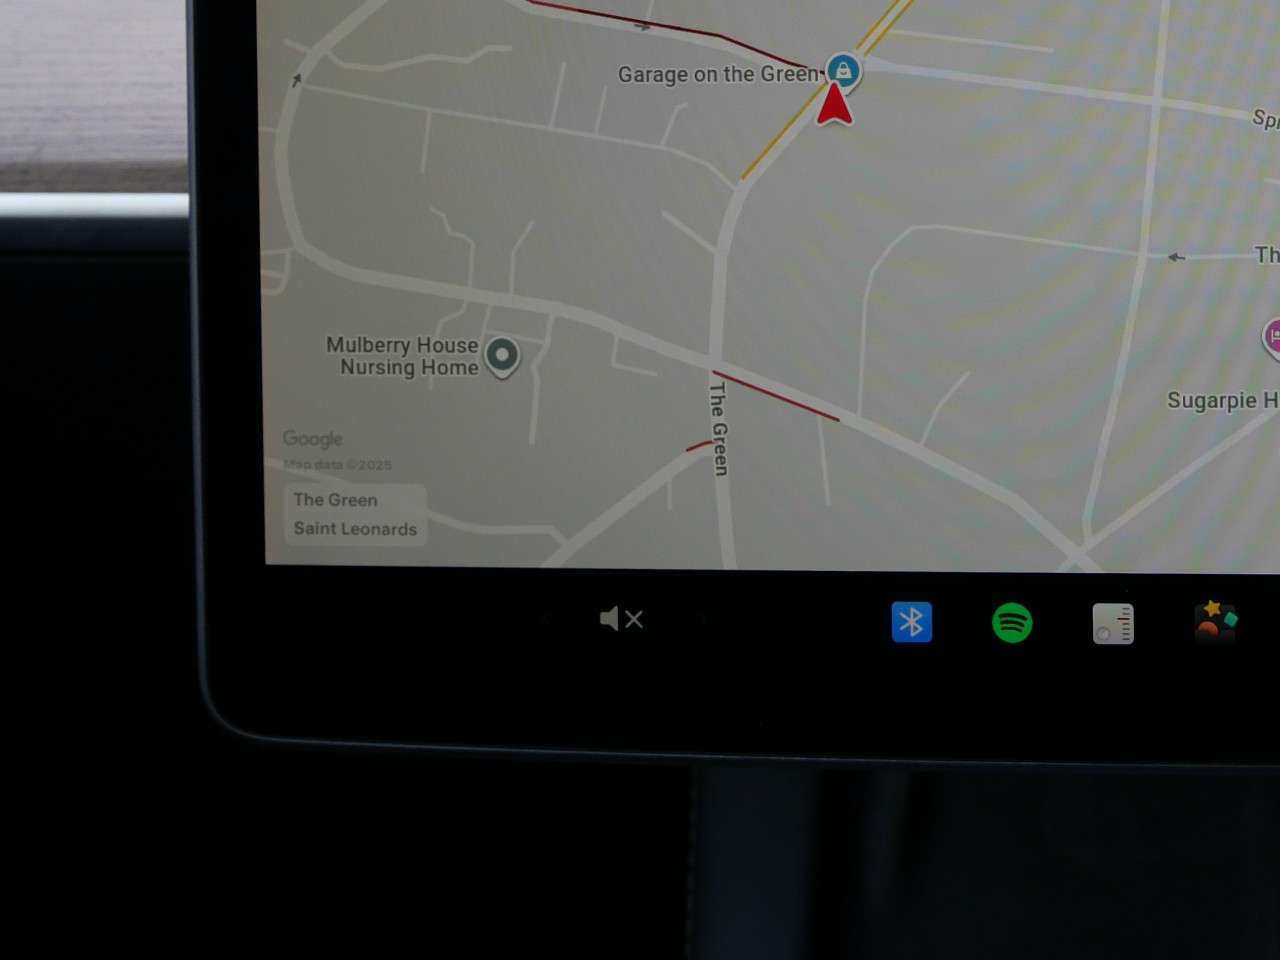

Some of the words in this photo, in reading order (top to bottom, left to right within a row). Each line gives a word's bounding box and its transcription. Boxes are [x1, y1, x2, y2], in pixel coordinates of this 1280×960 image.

[618, 65, 689, 88] Garage
[694, 68, 718, 82] on
[724, 64, 755, 82] the
[760, 64, 819, 82] Green
[326, 336, 410, 358] Mulberry
[417, 337, 479, 354] House
[341, 358, 415, 380] Nursing
[421, 358, 480, 376] Home
[710, 381, 726, 417] The
[1168, 392, 1257, 414] Sugarpie
[282, 429, 344, 451] Google
[713, 423, 728, 477] Green
[294, 492, 324, 507] The
[328, 492, 378, 508] Green
[294, 521, 337, 536] Saint
[341, 521, 418, 537] Leonards
